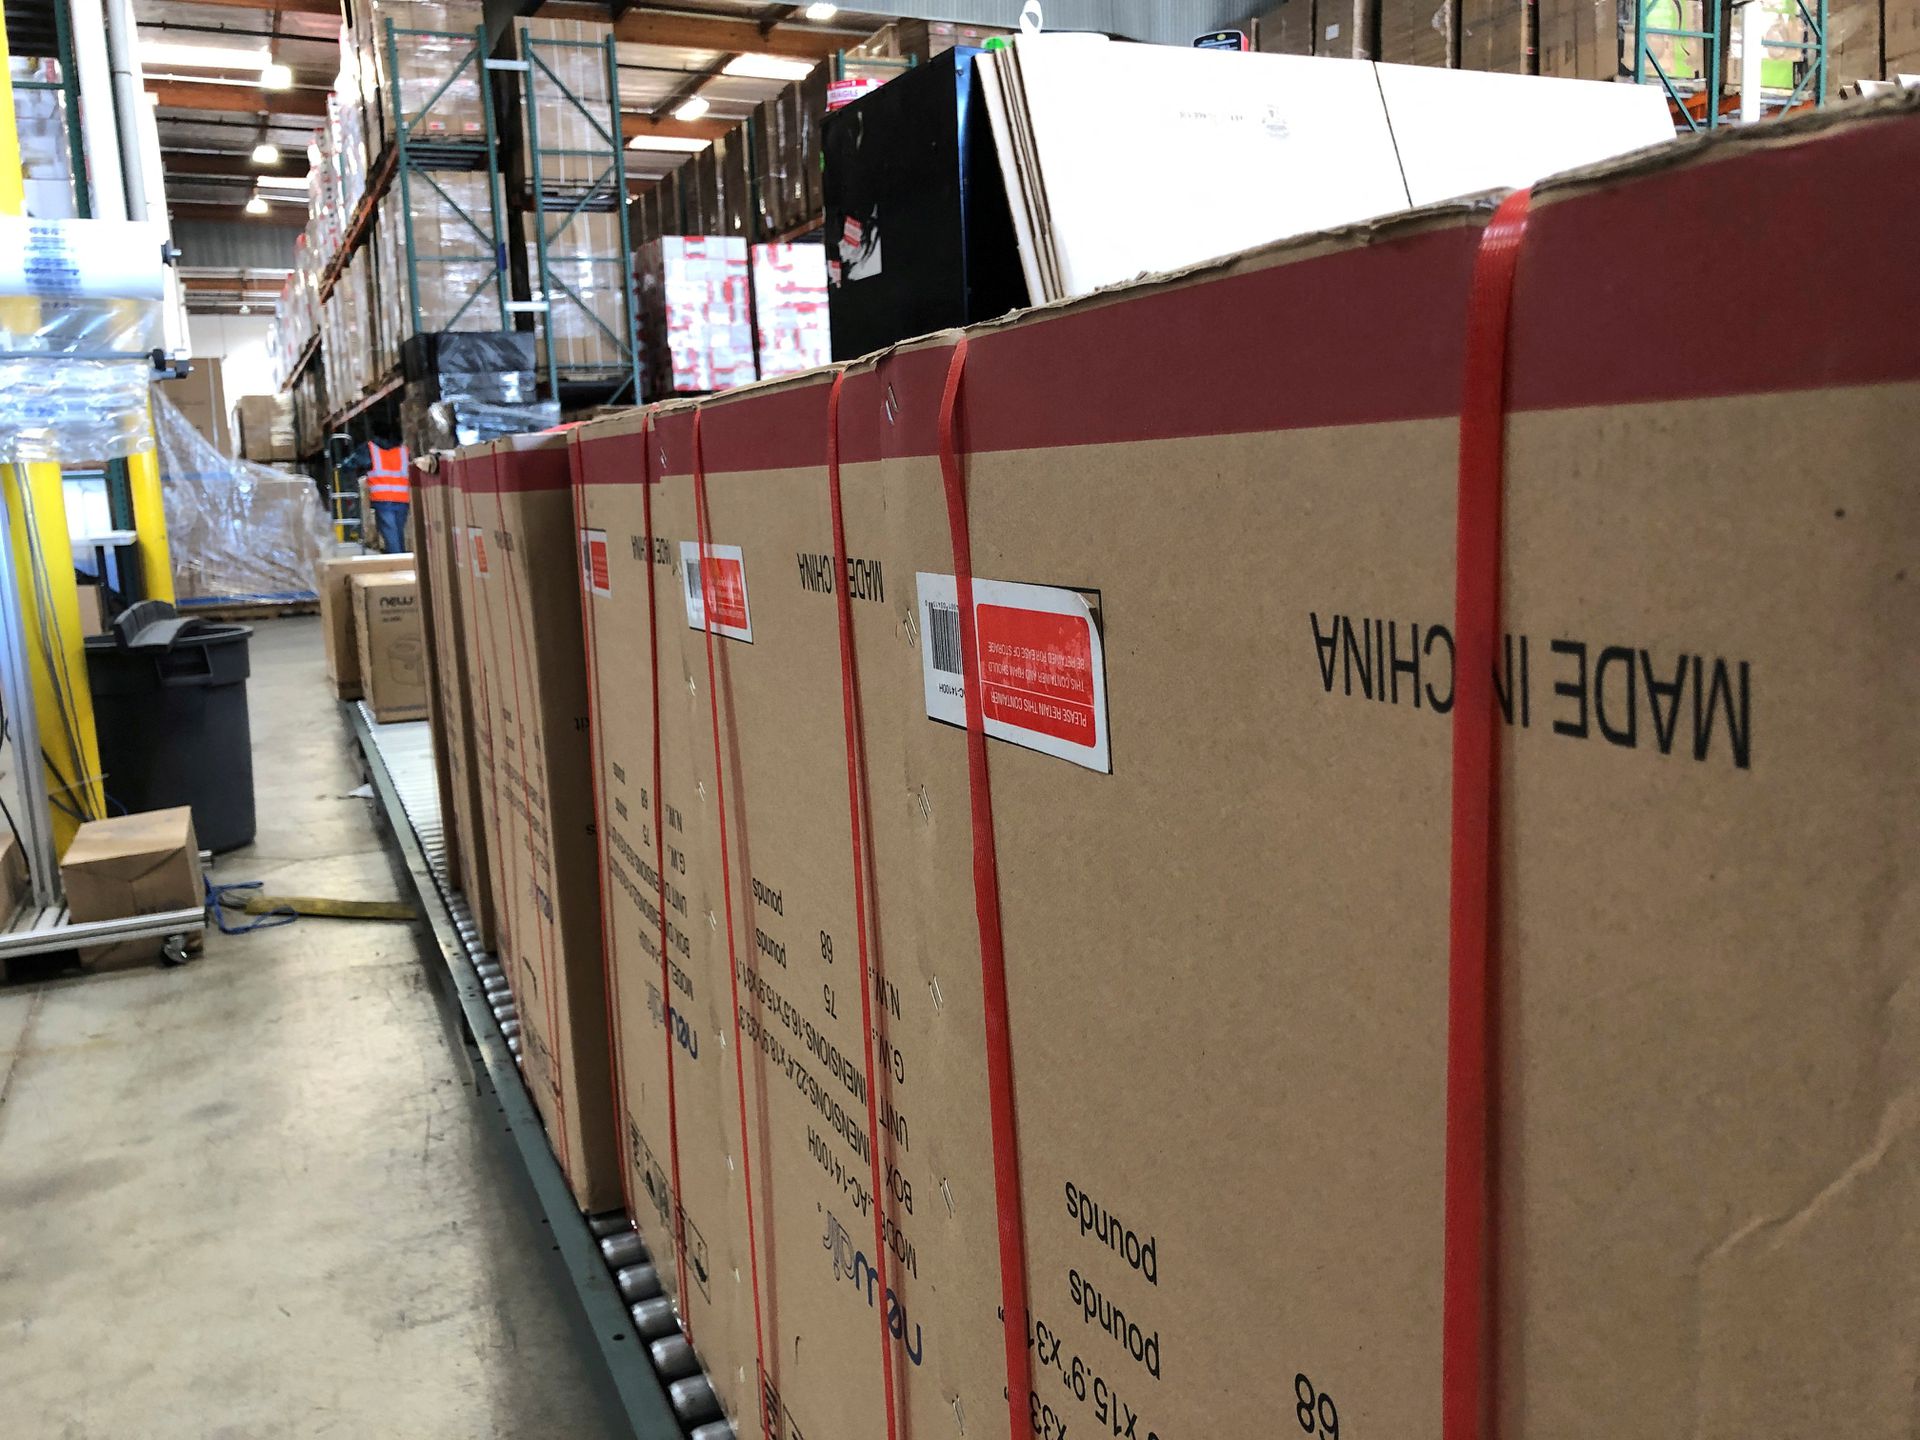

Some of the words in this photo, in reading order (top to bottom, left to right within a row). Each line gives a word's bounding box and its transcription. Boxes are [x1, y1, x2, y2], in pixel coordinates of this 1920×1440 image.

[796, 553, 833, 595] CHINA
[847, 558, 885, 604] MADE
[1070, 678, 1085, 692] THIS
[1310, 612, 1457, 714] CHINA
[1491, 634, 1530, 728] IN
[938, 683, 965, 698] C-14100H
[990, 691, 1023, 710] CONTAINER
[1023, 698, 1039, 714] THIS
[1038, 702, 1062, 720] RETAIN
[1550, 639, 1752, 770] MADE
[1062, 708, 1087, 728] PLEASE
[752, 878, 784, 918] pounds
[756, 928, 787, 970] pounds
[819, 930, 833, 964] 68
[823, 984, 838, 1020] 75
[868, 966, 901, 1021] N.W.:
[872, 1028, 905, 1085] G.W.:
[880, 1096, 910, 1153] UNIT
[885, 1157, 914, 1217] BOX
[1065, 1181, 1158, 1287] pounds
[1068, 1268, 1161, 1381] pounds
[1295, 1373, 1339, 1440] 68
